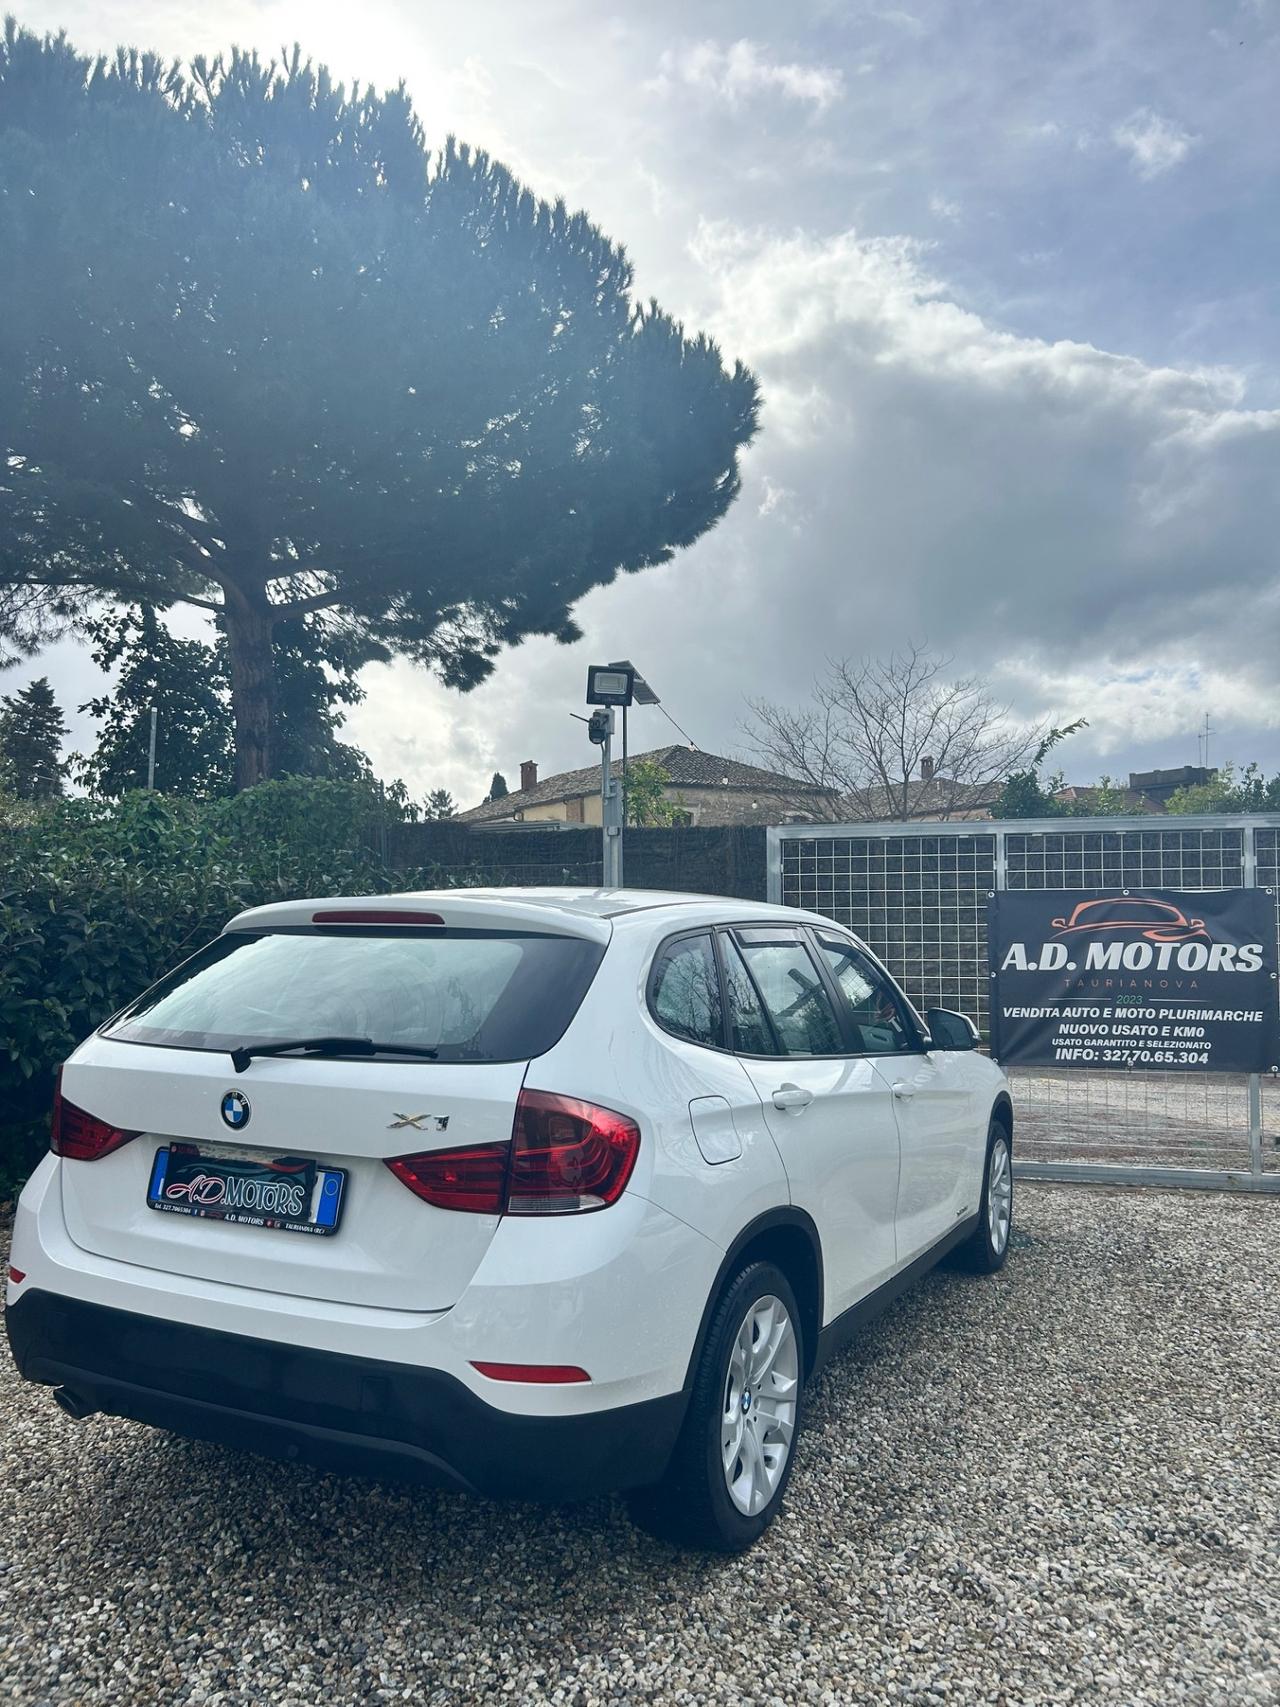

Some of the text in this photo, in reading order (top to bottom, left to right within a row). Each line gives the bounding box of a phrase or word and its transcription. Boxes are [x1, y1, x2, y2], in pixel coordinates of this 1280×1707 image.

[1001, 942, 1263, 972] A.D. MOTORS
[1064, 979, 1199, 989] TAURIANOVA
[1116, 995, 1143, 1005] 2023
[1003, 1007, 1263, 1022] VENDITA AUTO E MOTO PLURIMARCHE
[1059, 1023, 1109, 1035] NUOVO
[1112, 1024, 1159, 1036] USATO
[1162, 1026, 1170, 1037] E
[1052, 1038, 1083, 1046] USATO
[1084, 1039, 1137, 1047] GARANTITO
[1146, 1040, 1211, 1050] SELEZIONATO
[1055, 1049, 1209, 1064] INFO: 327.70.65.304
[238, 1216, 265, 1226] MOTORS
